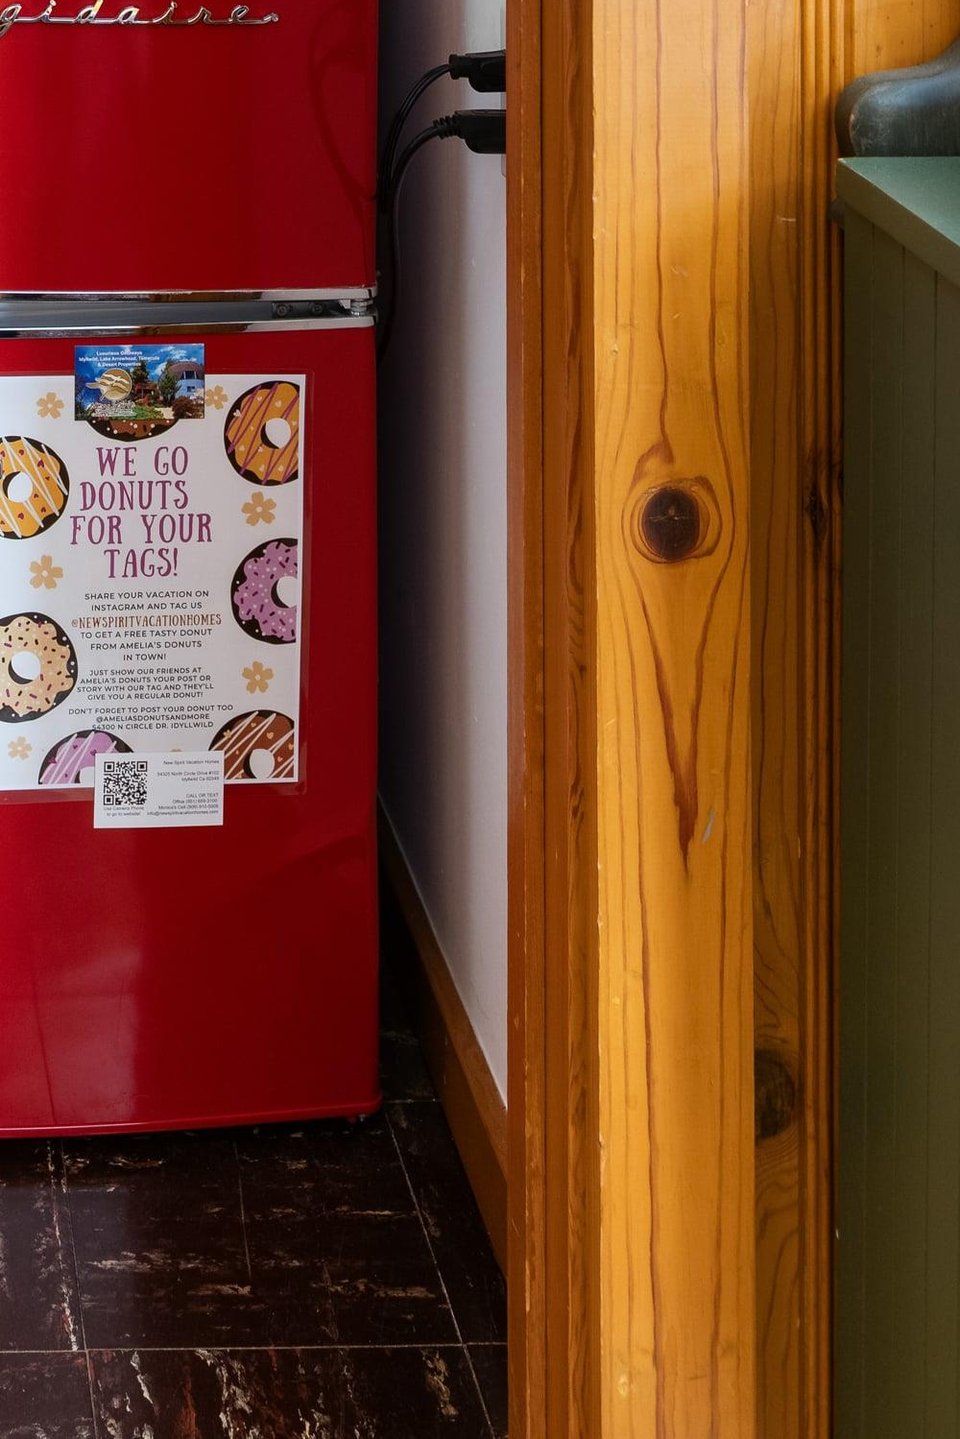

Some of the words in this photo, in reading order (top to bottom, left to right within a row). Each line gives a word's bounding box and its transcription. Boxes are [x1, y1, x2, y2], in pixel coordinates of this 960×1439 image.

[96, 446, 137, 476] WE
[154, 446, 189, 476] GO
[79, 480, 189, 511] DONUTS
[70, 515, 123, 545] FOR
[140, 513, 212, 544] YOUR
[104, 547, 179, 578] TAGS!
[84, 592, 115, 600] SHARE
[118, 591, 143, 599] YOUR
[146, 590, 192, 599] VACATION
[91, 603, 144, 612] INSTAGRAM
[147, 602, 167, 610] AND
[170, 602, 188, 610] TAG
[190, 601, 202, 609] US
[71, 613, 222, 629] @NEWSPIRITVACATIONHOMES
[80, 631, 92, 639] TO
[95, 631, 113, 639] GET
[115, 630, 121, 638] A
[124, 630, 147, 638] FREE
[150, 629, 177, 637] TASTY
[180, 628, 212, 636] DONUT
[90, 643, 117, 651] FROM
[119, 641, 162, 650] AMELIA'S
[164, 640, 202, 649] DONUTS
[135, 653, 167, 661] TOWN!
[89, 669, 108, 677] JUST
[156, 667, 190, 675] FRIENDS
[80, 677, 117, 685] AMELIA'S
[119, 676, 151, 684] DONUTS
[96, 713, 210, 723] @AMELIASDONUTSANDMORE
[92, 723, 116, 731] 54300
[125, 722, 154, 730] CIRCLE
[171, 721, 214, 729] IDYLLWILD
